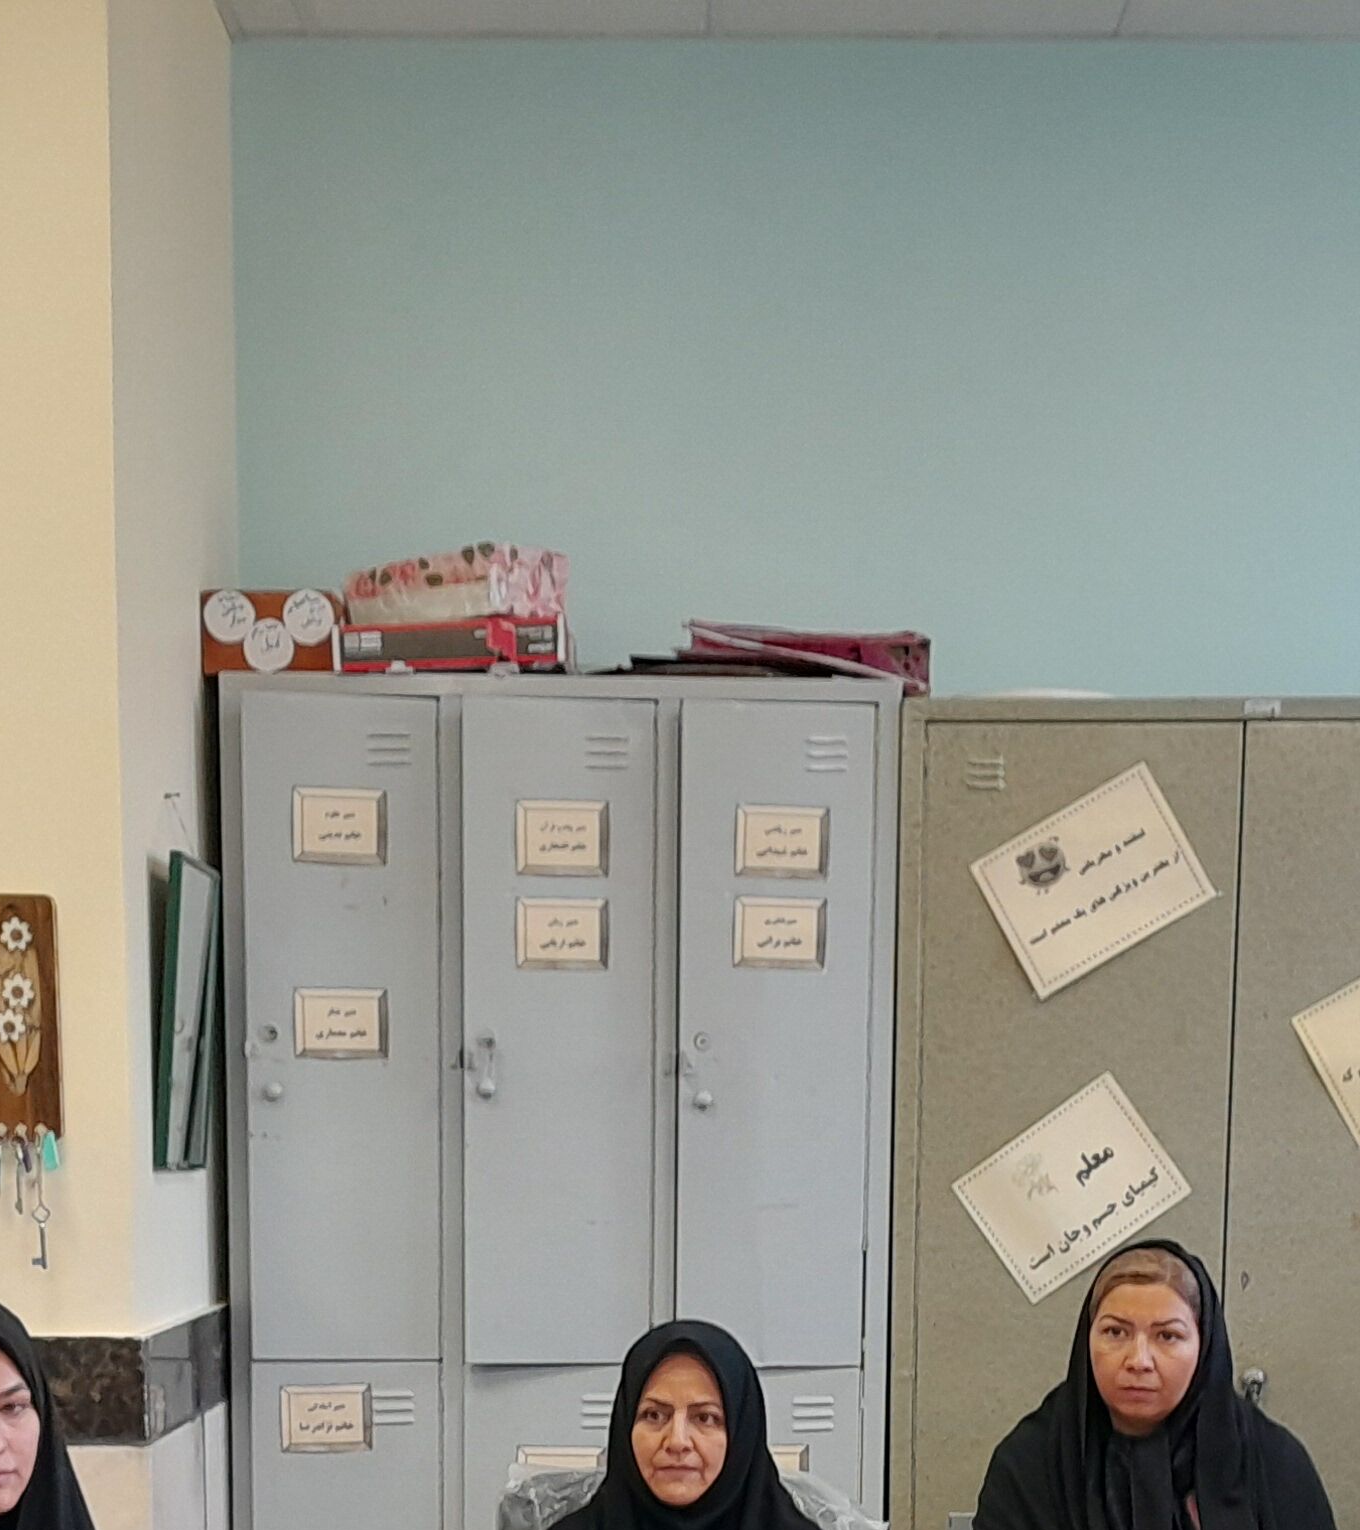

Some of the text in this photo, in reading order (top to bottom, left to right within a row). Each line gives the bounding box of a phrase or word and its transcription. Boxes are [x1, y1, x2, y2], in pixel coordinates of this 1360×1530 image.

[1075, 1145, 1115, 1188] معلم
[1121, 1166, 1159, 1208] کیمیای
[1091, 1201, 1120, 1230] جسم
[1028, 1243, 1056, 1271] است
